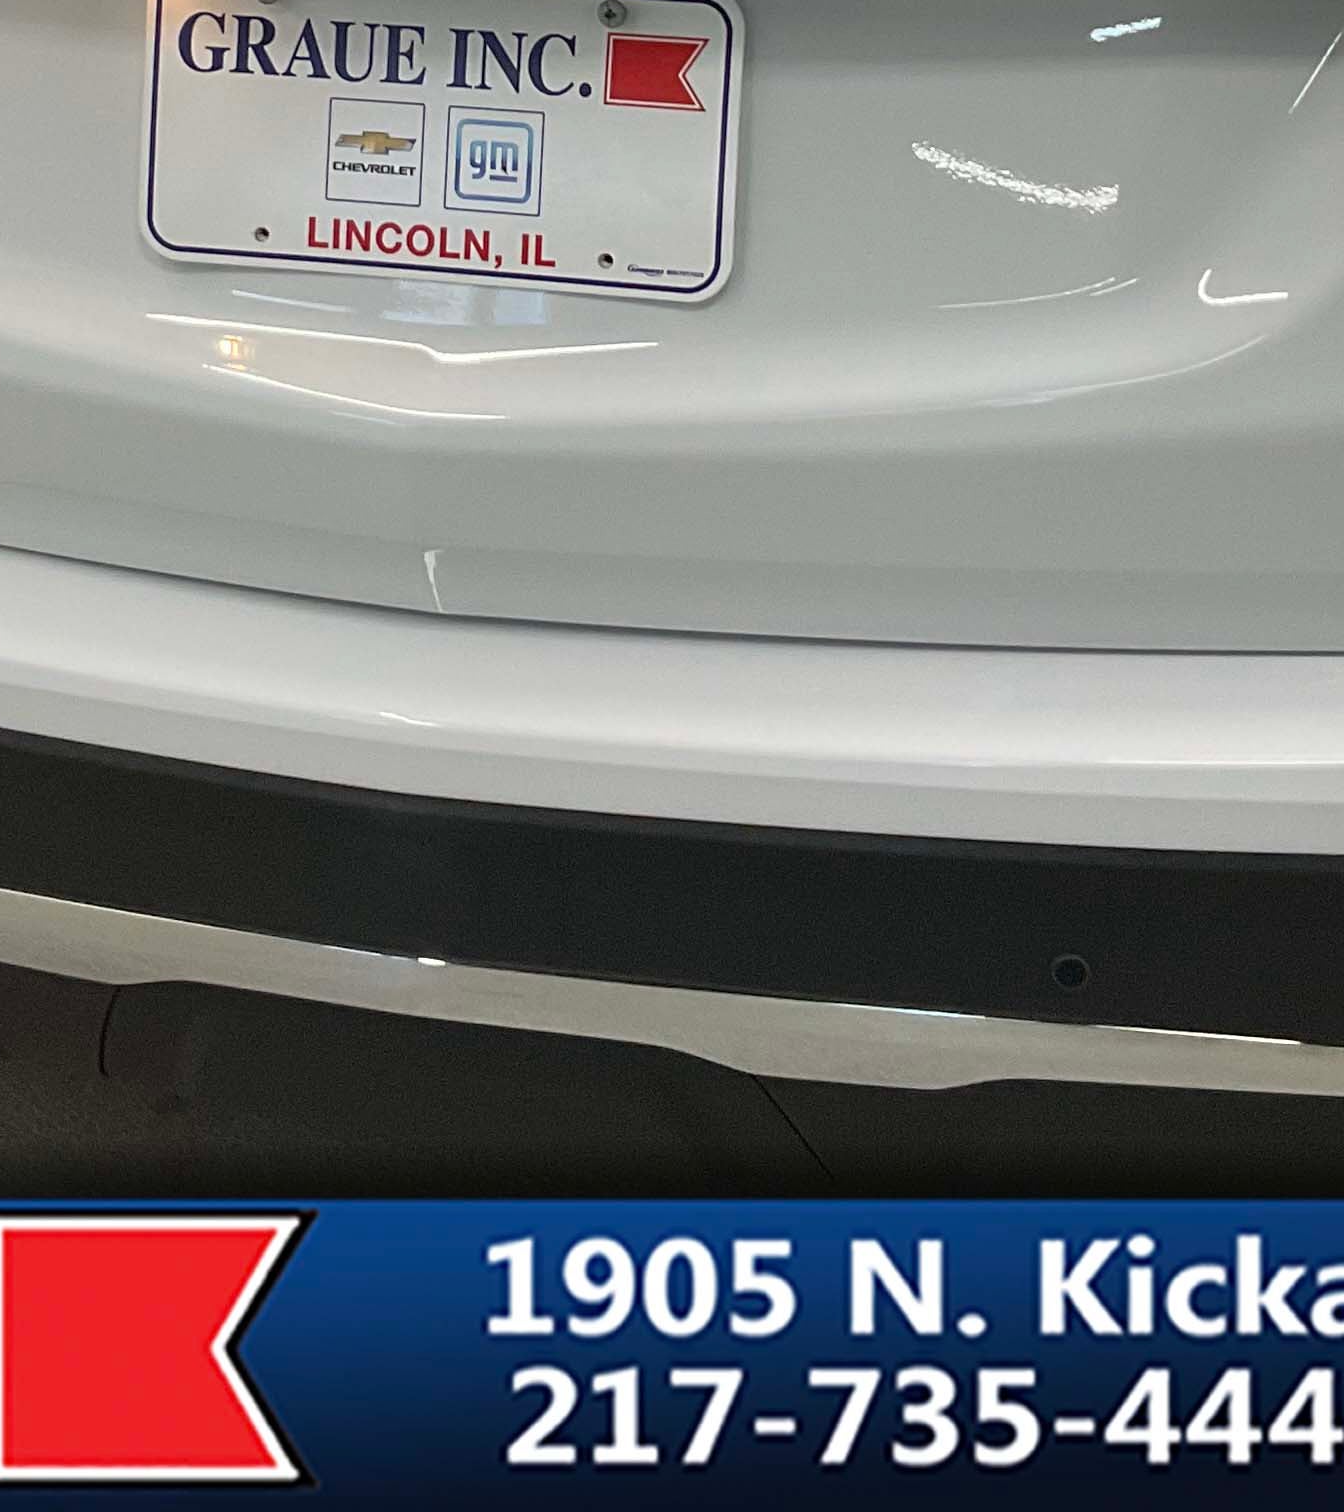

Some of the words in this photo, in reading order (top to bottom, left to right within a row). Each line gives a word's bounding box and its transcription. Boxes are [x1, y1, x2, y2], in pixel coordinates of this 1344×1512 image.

[177, 10, 426, 86] GRAUE
[446, 27, 592, 98] INC.
[332, 161, 417, 177] CHEVROLET
[306, 216, 503, 269] LINCOLN,
[520, 234, 556, 268] IL
